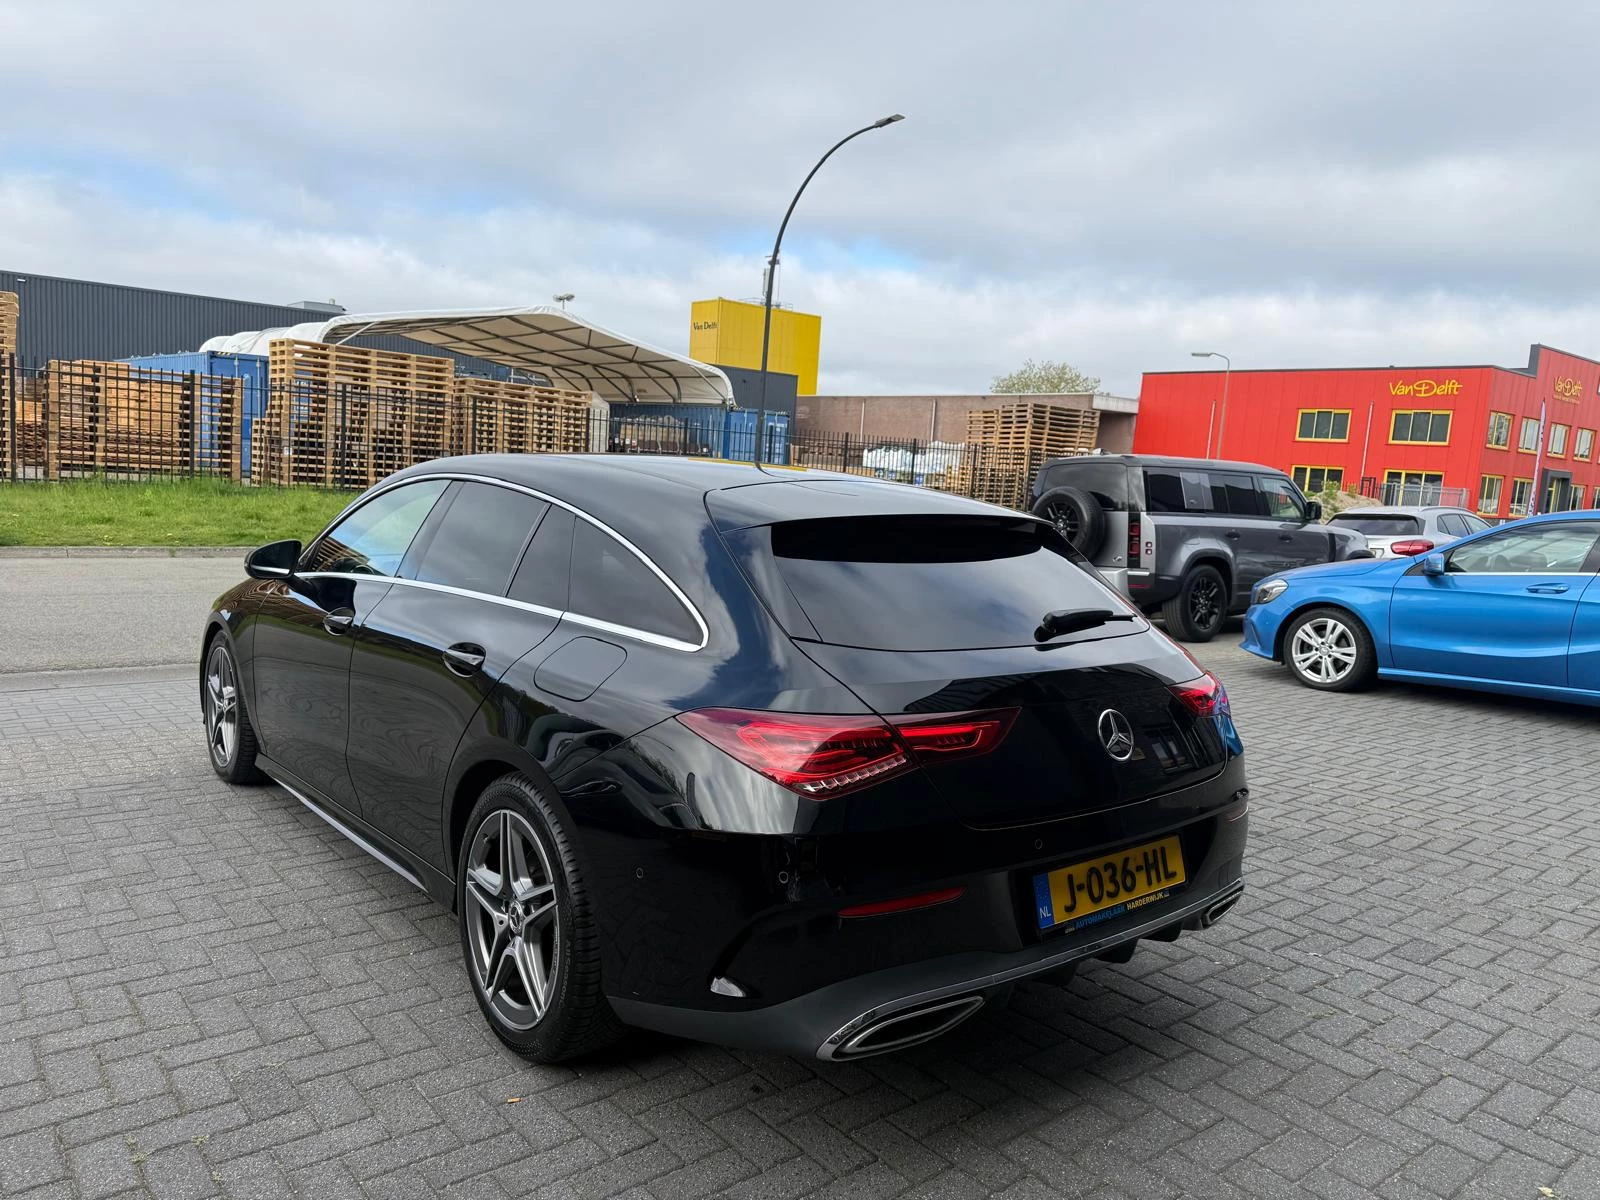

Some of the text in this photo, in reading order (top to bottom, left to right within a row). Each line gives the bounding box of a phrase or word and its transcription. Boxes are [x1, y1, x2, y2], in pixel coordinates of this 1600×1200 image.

[1064, 846, 1177, 913] J-036-HL
[1126, 892, 1164, 911] HARDERWIJK
[1039, 906, 1052, 919] NL
